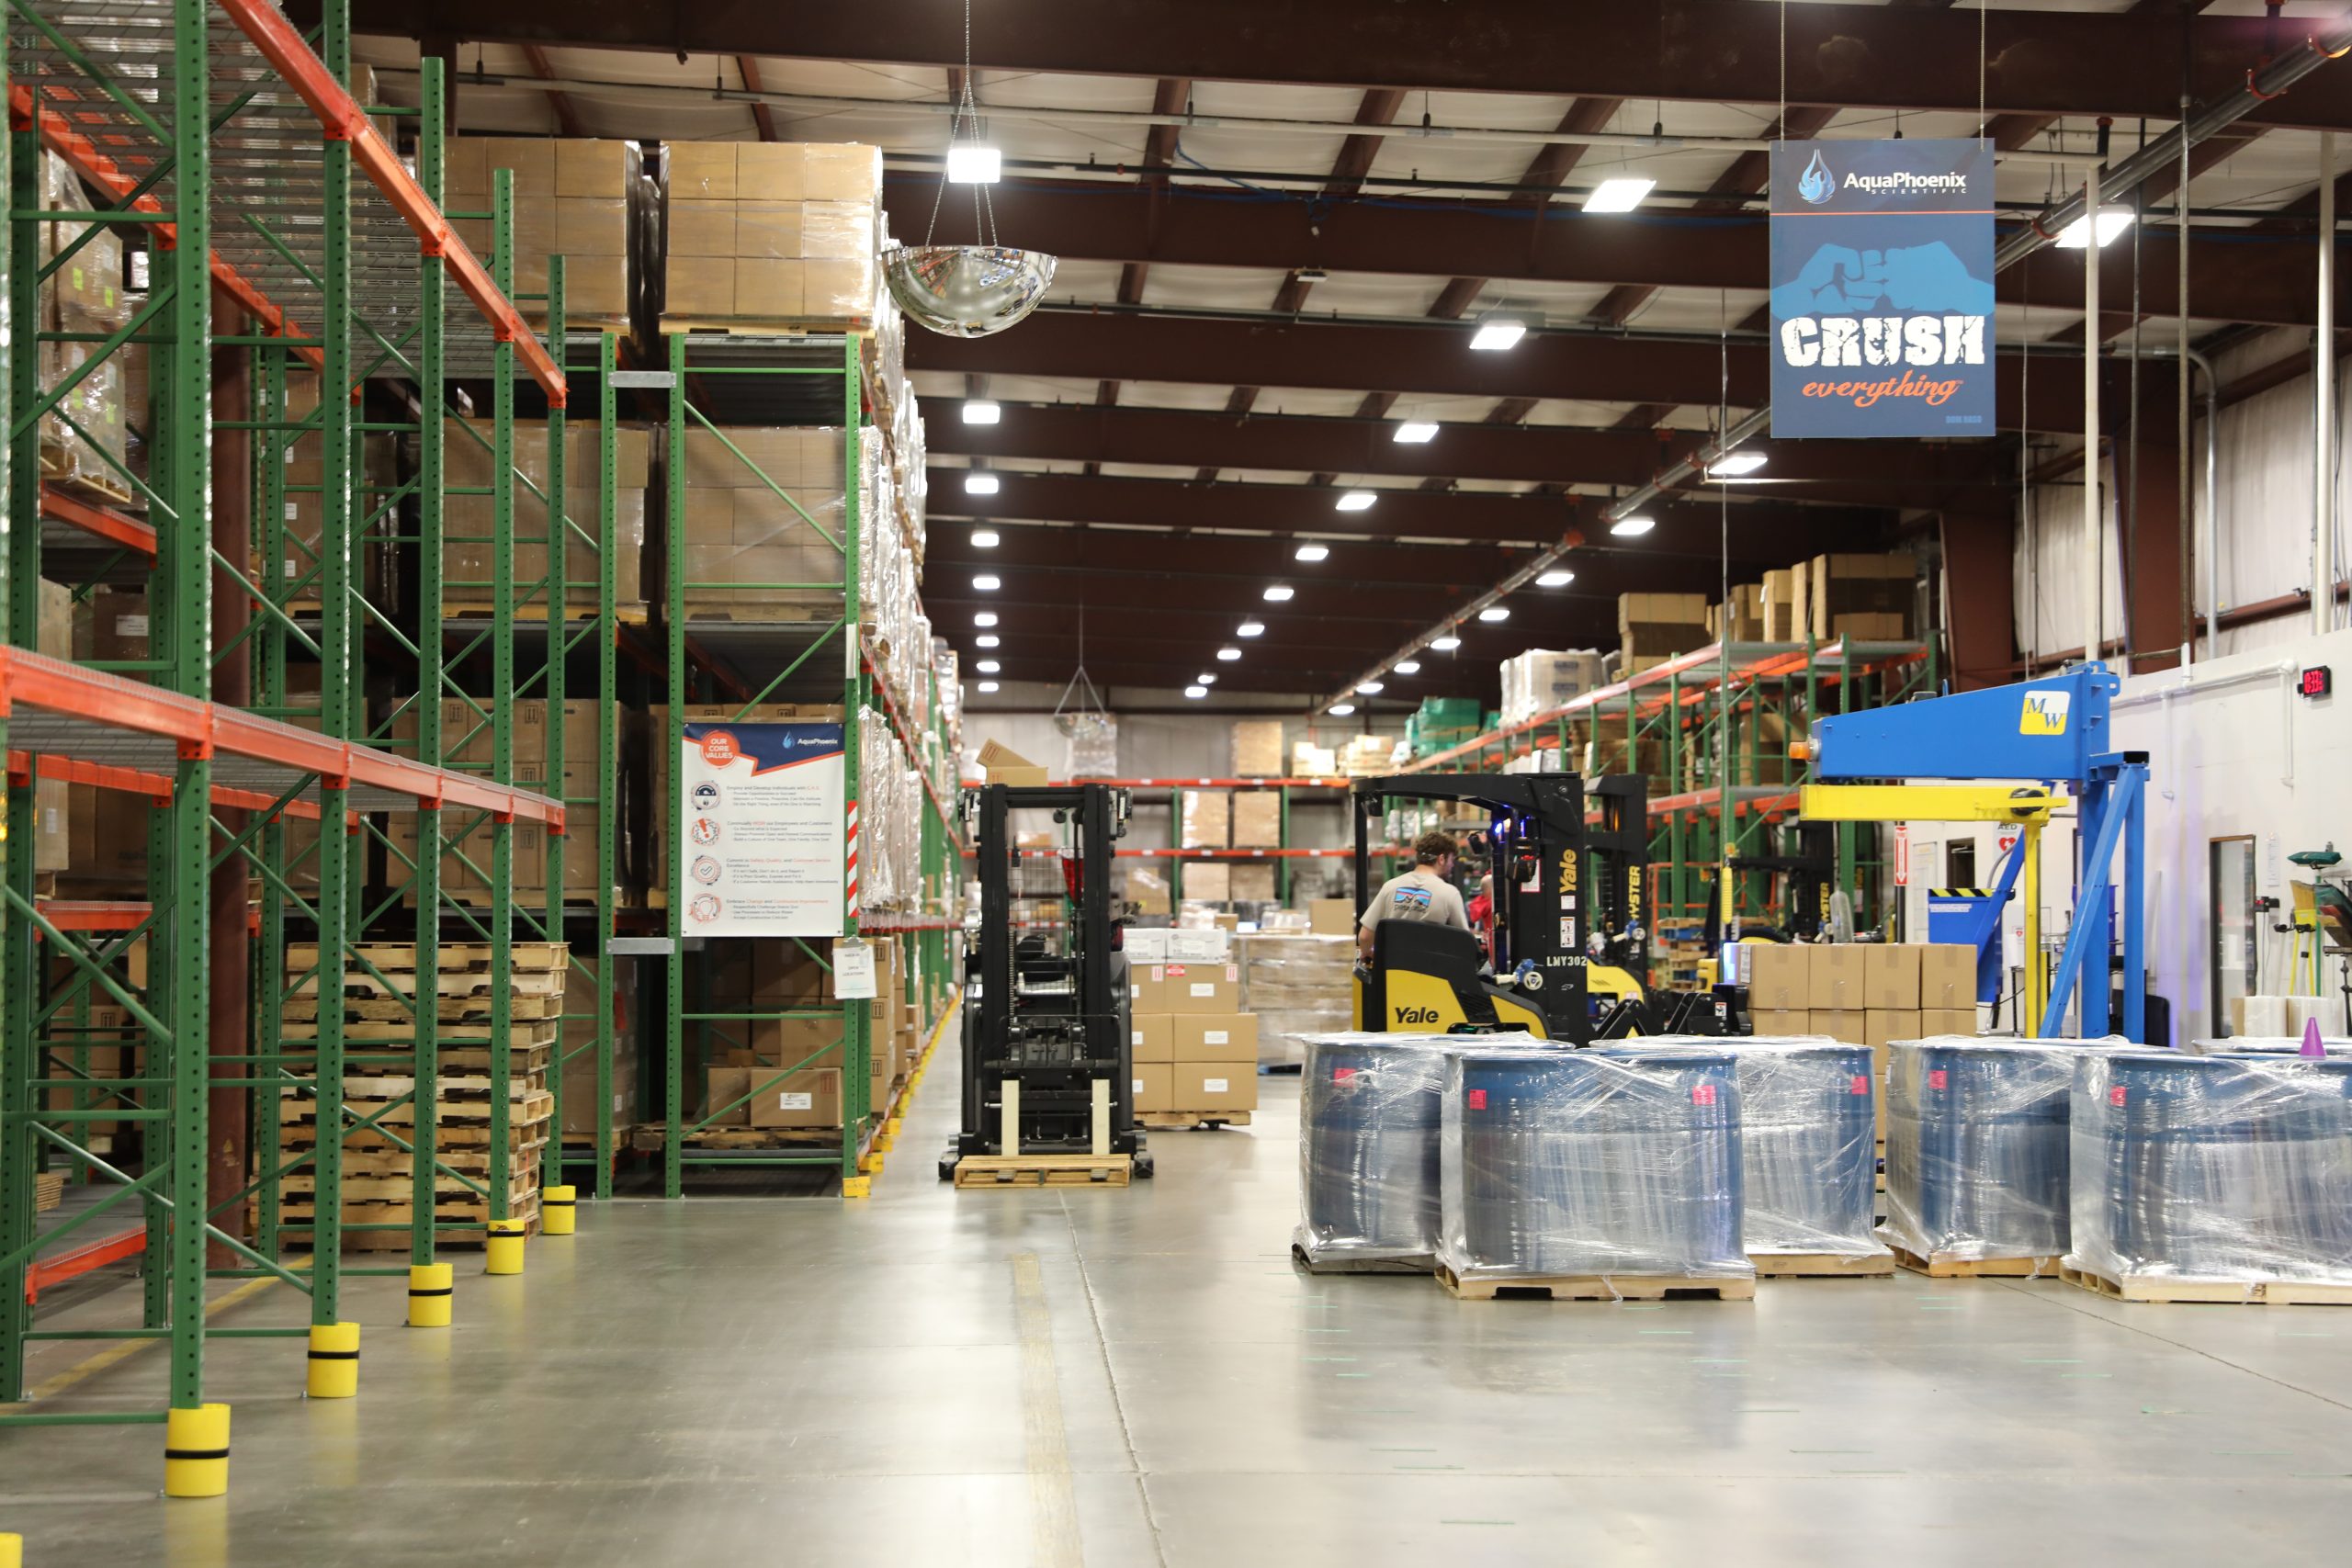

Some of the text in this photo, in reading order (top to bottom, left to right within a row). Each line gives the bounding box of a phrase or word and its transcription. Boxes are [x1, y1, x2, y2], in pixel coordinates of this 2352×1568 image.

[1843, 172, 1966, 191] AquaPhoenix
[1781, 315, 1985, 367] CRUSH
[1802, 369, 1961, 407] everything
[797, 738, 839, 746] AquaPhoenix
[1559, 849, 1577, 894] Yale
[1546, 956, 1587, 966] LMY302
[1395, 1007, 1439, 1023] Yale
